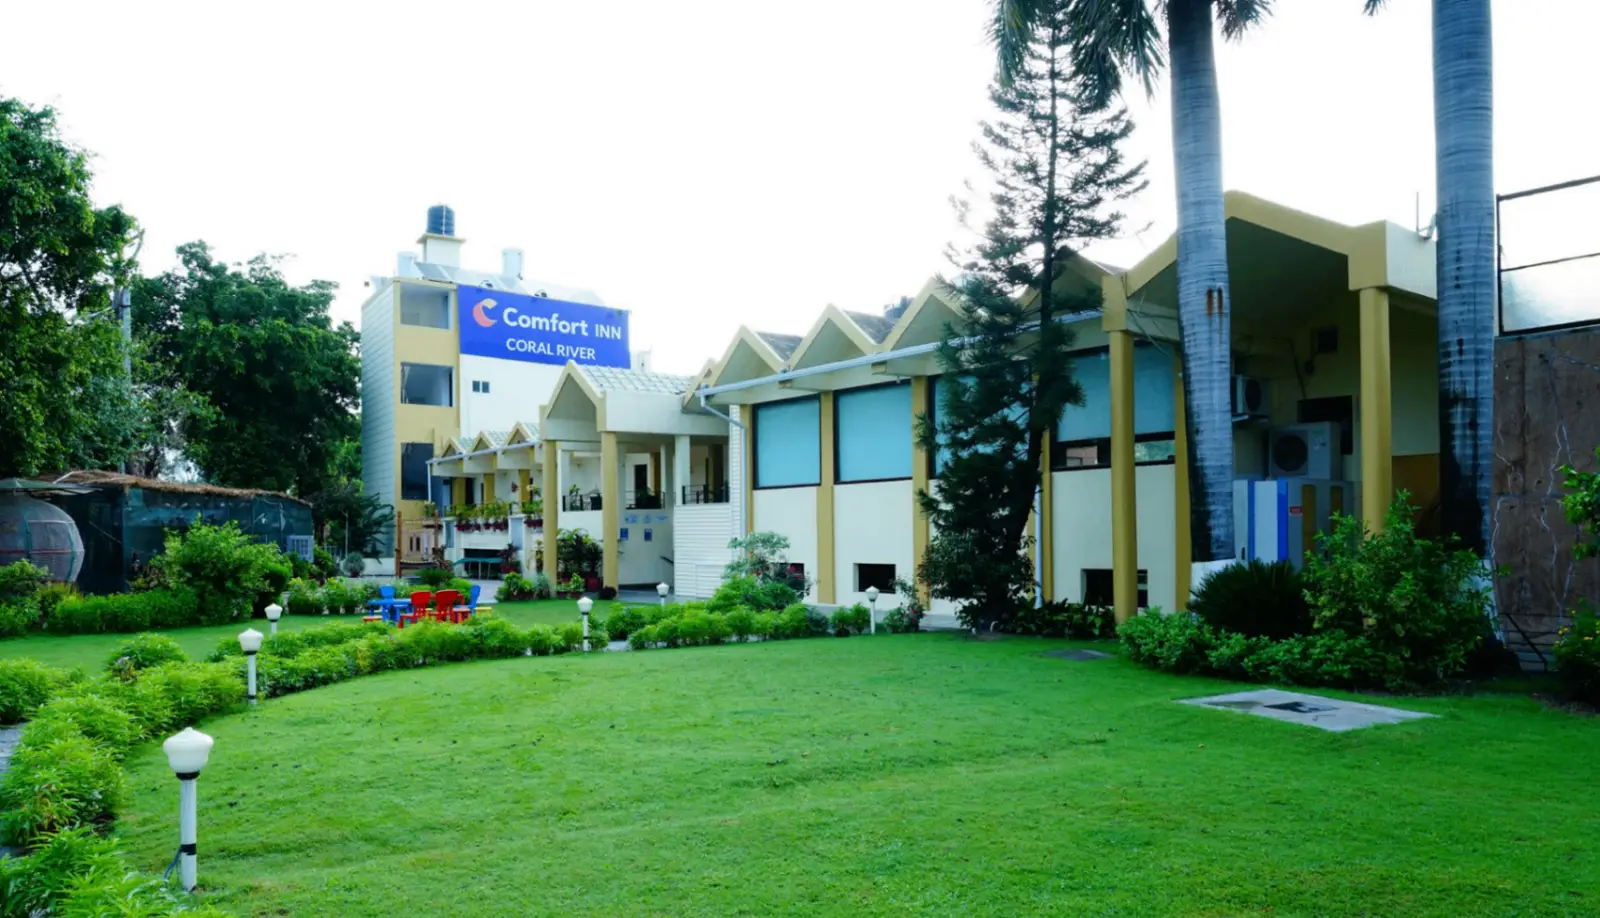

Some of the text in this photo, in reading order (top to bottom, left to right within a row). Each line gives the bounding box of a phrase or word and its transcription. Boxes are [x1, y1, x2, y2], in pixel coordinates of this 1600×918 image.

[503, 307, 588, 336] Comfort
[595, 323, 621, 340] INN
[506, 338, 596, 360] CORAL RIVER
